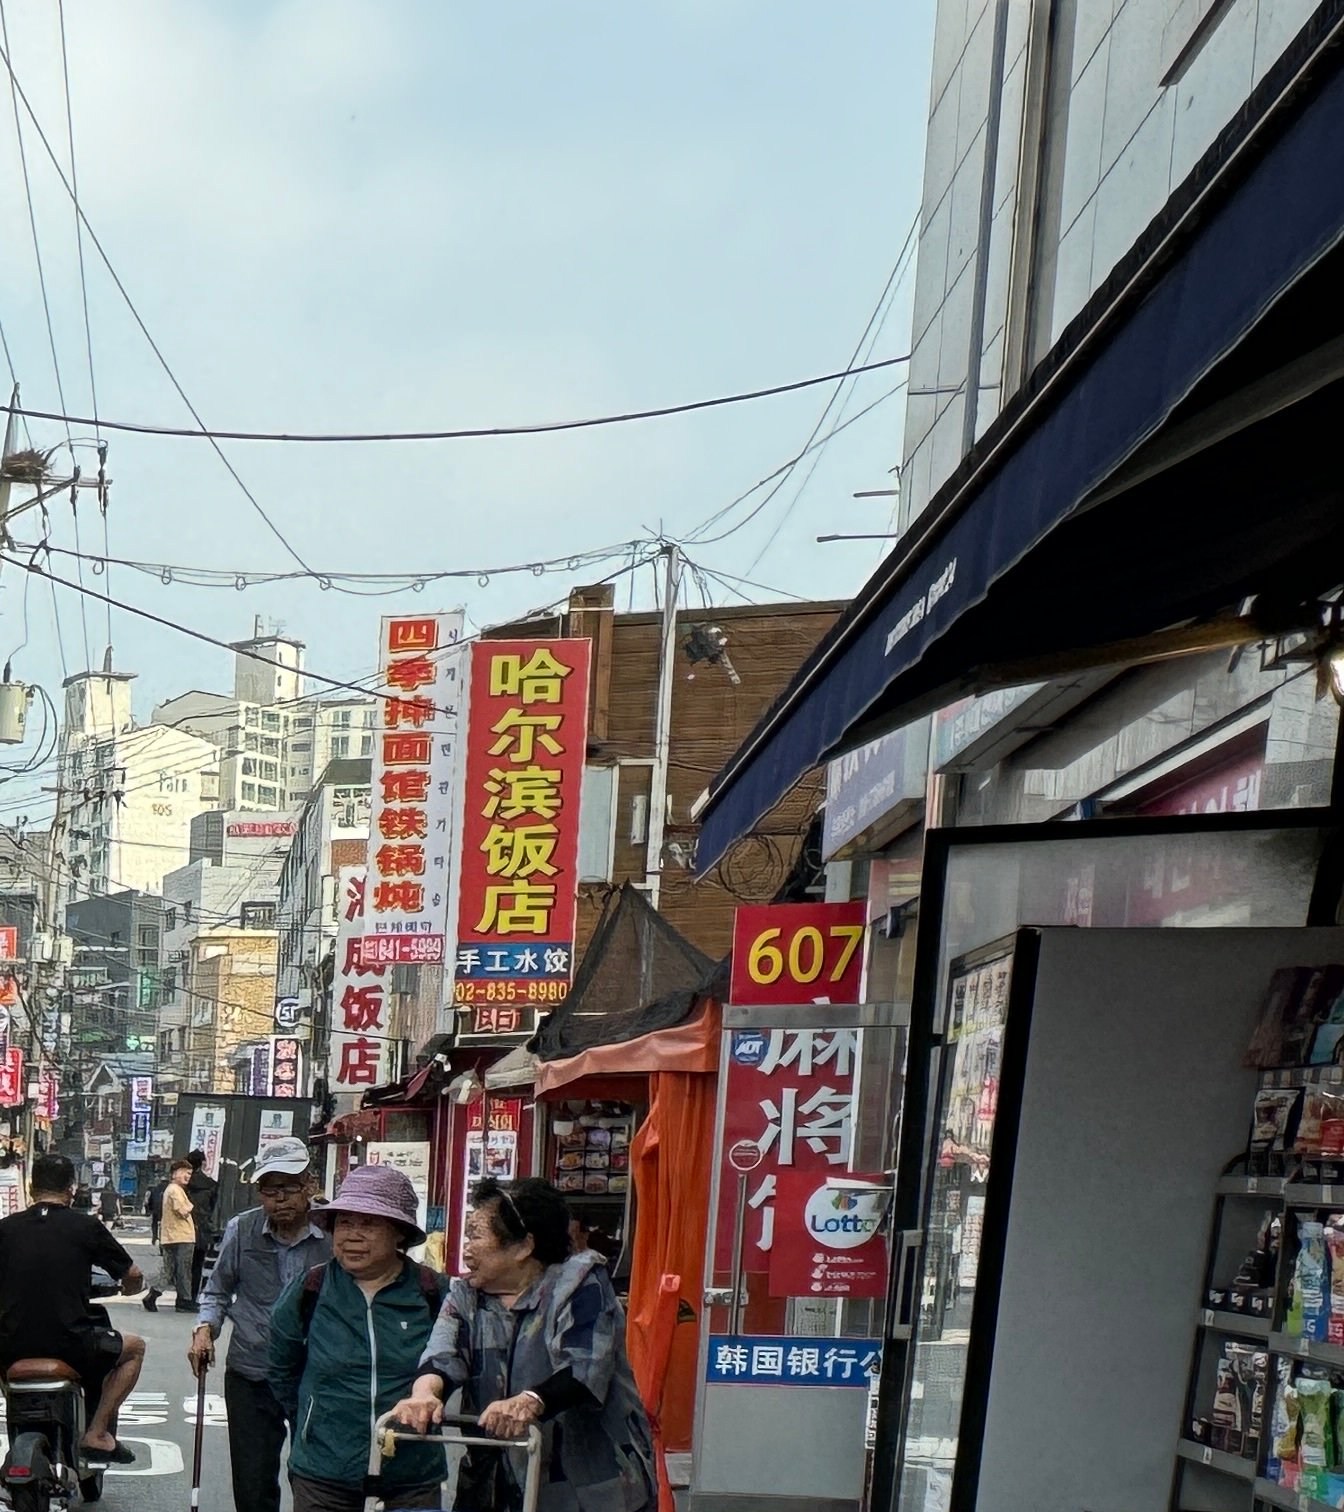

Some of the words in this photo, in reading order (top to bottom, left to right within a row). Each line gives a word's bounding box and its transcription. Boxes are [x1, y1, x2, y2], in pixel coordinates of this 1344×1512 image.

[473, 647, 573, 937] 哈尔滨饭店
[456, 947, 569, 974] 手工水饺
[748, 925, 863, 984] 607
[748, 996, 856, 1253] 麻将
[810, 1214, 873, 1233] Lotto
